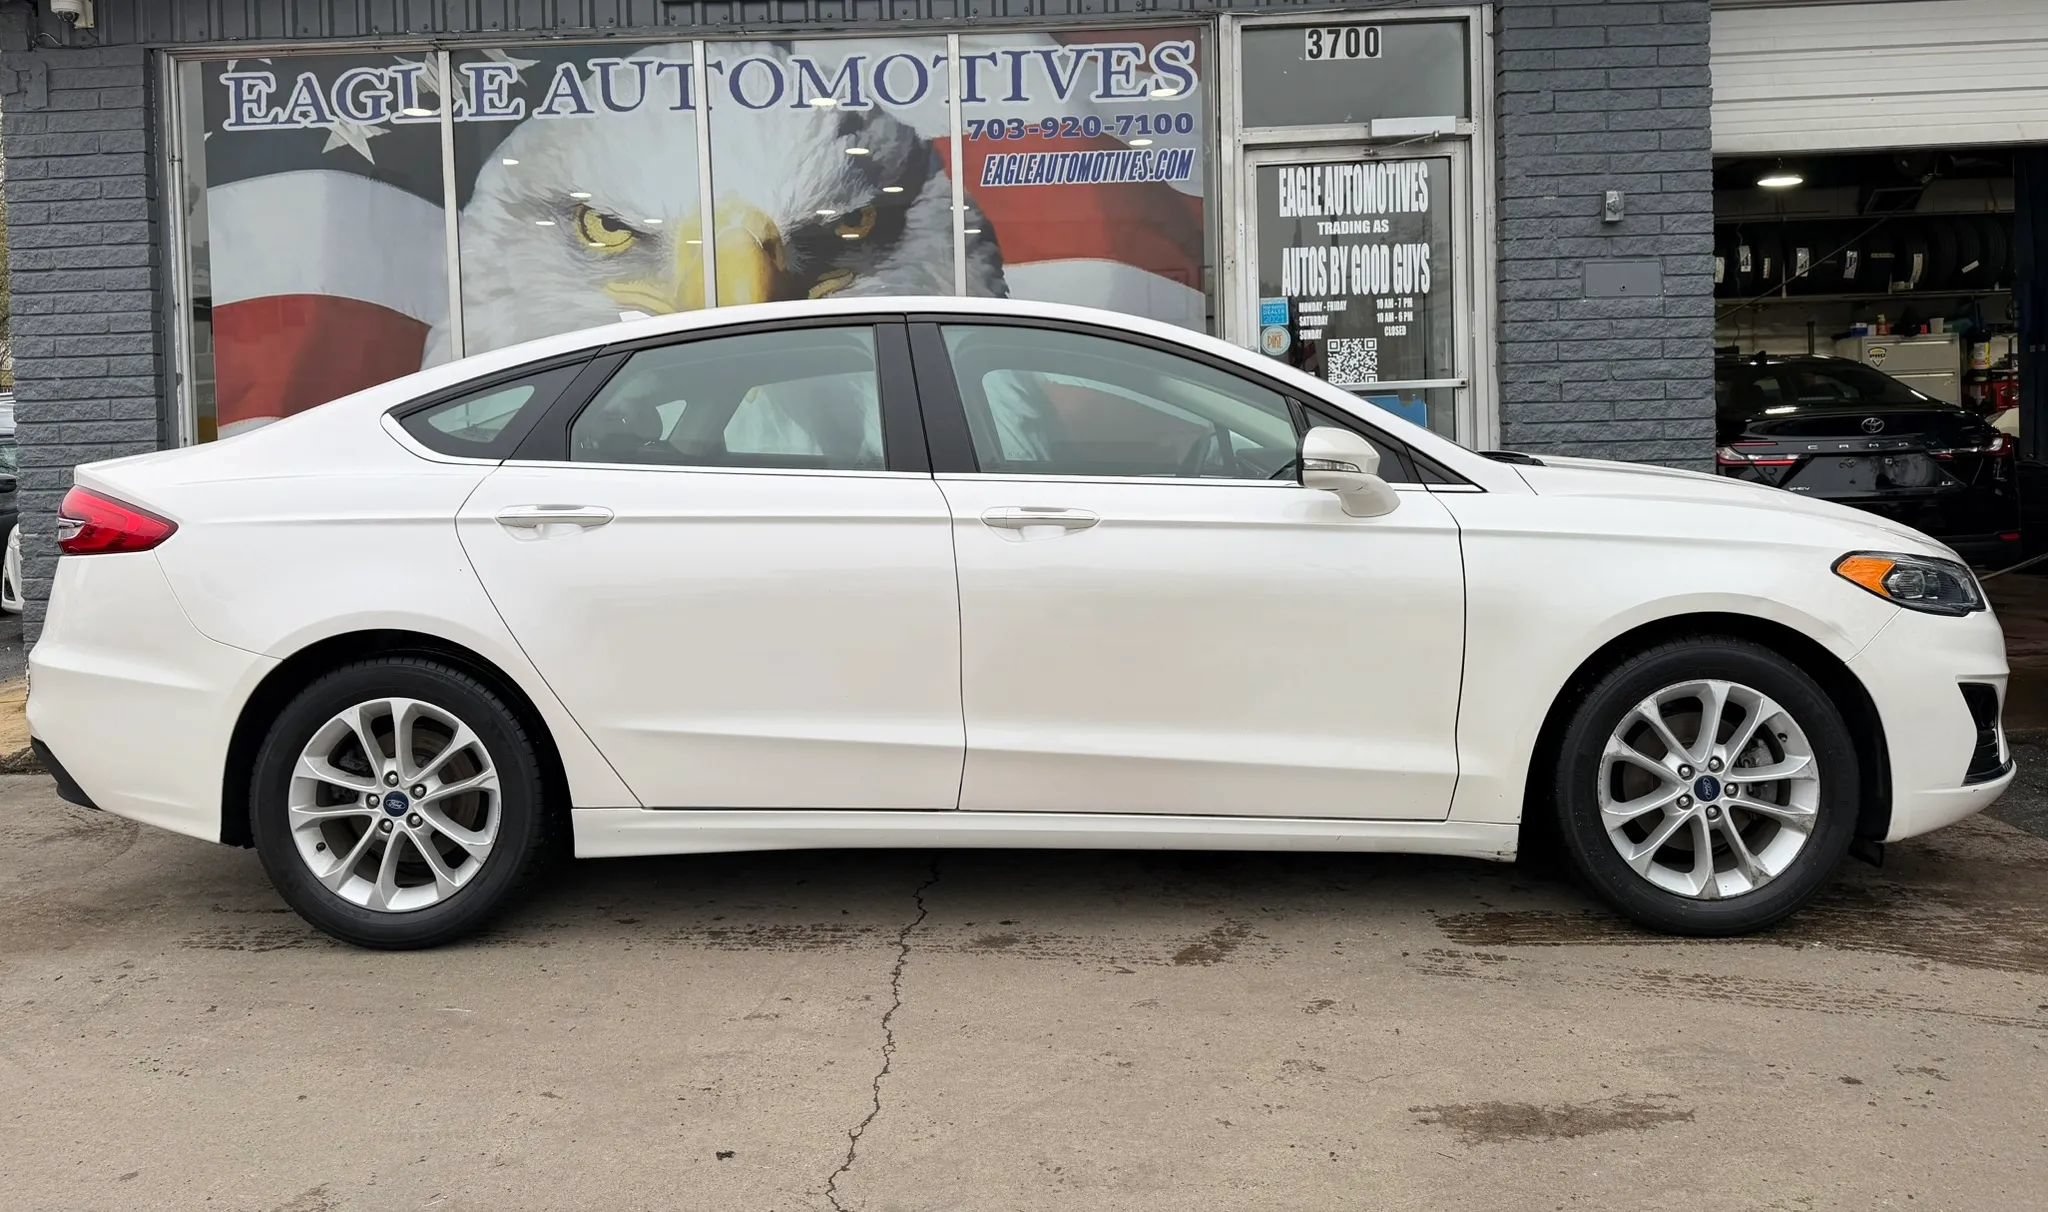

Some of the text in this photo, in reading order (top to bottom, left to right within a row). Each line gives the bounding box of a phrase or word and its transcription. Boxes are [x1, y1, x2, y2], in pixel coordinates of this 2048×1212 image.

[1307, 27, 1380, 60] 3700
[219, 39, 1198, 131] EAGLE AUTOMOTIVES
[967, 112, 1194, 142] 703-920-7100
[981, 148, 1196, 187] EAGLEAUTOMOTIVES.COM
[1279, 162, 1429, 218] EAGLE AUTOMOTIVES
[1317, 219, 1390, 235] TRADING AS
[1281, 242, 1431, 297] AUTOS BY GOOD GUYS
[1263, 308, 1285, 316] DEALER
[1299, 302, 1323, 313] MONDAY
[1326, 300, 1347, 312] FRIDAY
[1376, 298, 1384, 309] 10
[1384, 298, 1394, 309] AM
[1403, 297, 1413, 309] PM
[1298, 314, 1329, 327] SATURDAY
[1376, 312, 1384, 323] 10
[1384, 312, 1394, 323] AM
[1398, 311, 1403, 322] 6
[1403, 311, 1414, 322] PM
[1298, 325, 1407, 340] SUNDAY CLOSED
[1808, 441, 1937, 450] CAMRY
